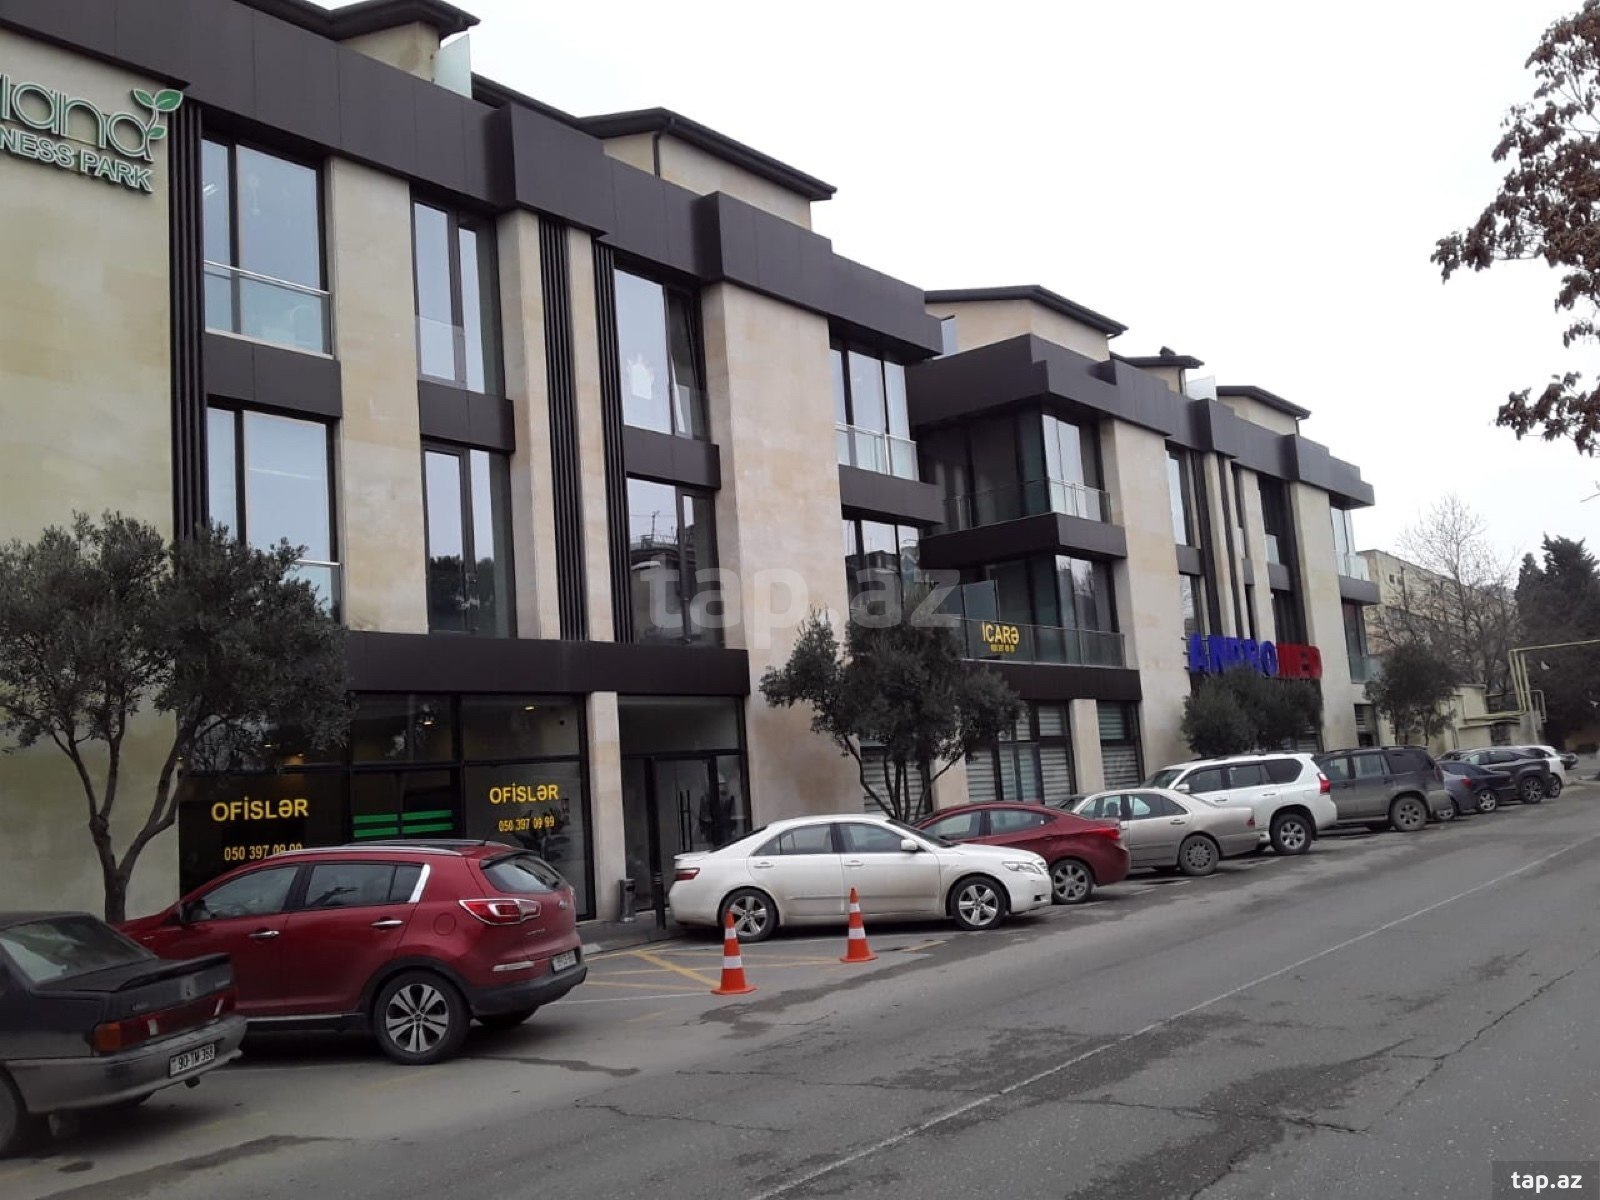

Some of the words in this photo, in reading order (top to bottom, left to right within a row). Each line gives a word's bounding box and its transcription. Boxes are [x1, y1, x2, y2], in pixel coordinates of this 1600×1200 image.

[80, 150, 153, 192] PARK
[211, 796, 309, 821] OFİSLƏR
[224, 846, 246, 861] 050
[248, 844, 270, 860] 397
